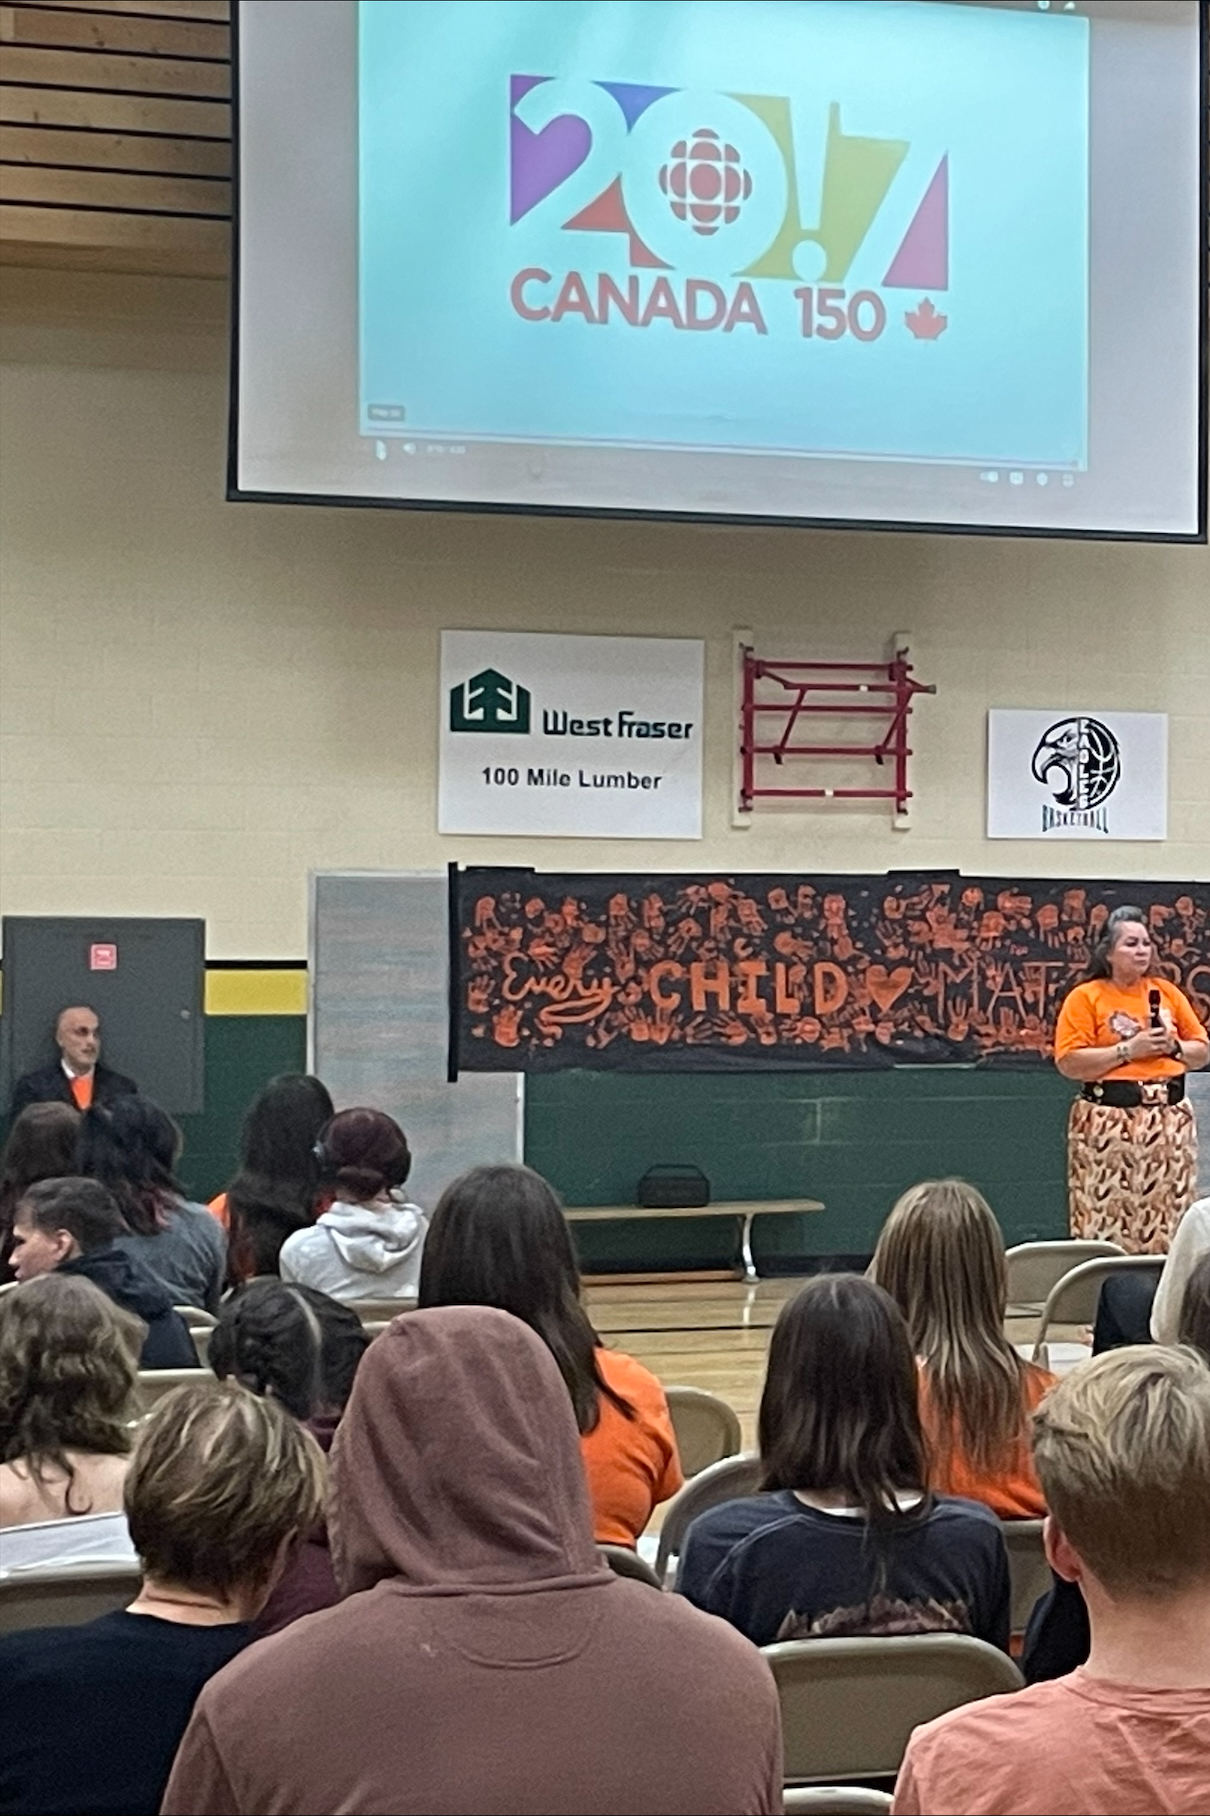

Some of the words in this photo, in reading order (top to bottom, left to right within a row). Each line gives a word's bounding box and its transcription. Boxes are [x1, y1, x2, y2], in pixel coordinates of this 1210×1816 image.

[510, 267, 768, 335] CANADA
[793, 286, 887, 342] 150
[542, 708, 613, 737] West
[617, 710, 694, 739] Fraser
[482, 767, 520, 787] 100
[527, 768, 572, 788] Mile
[578, 769, 663, 790] Lumber
[502, 951, 622, 1024] Every
[650, 959, 849, 1017] CHILD
